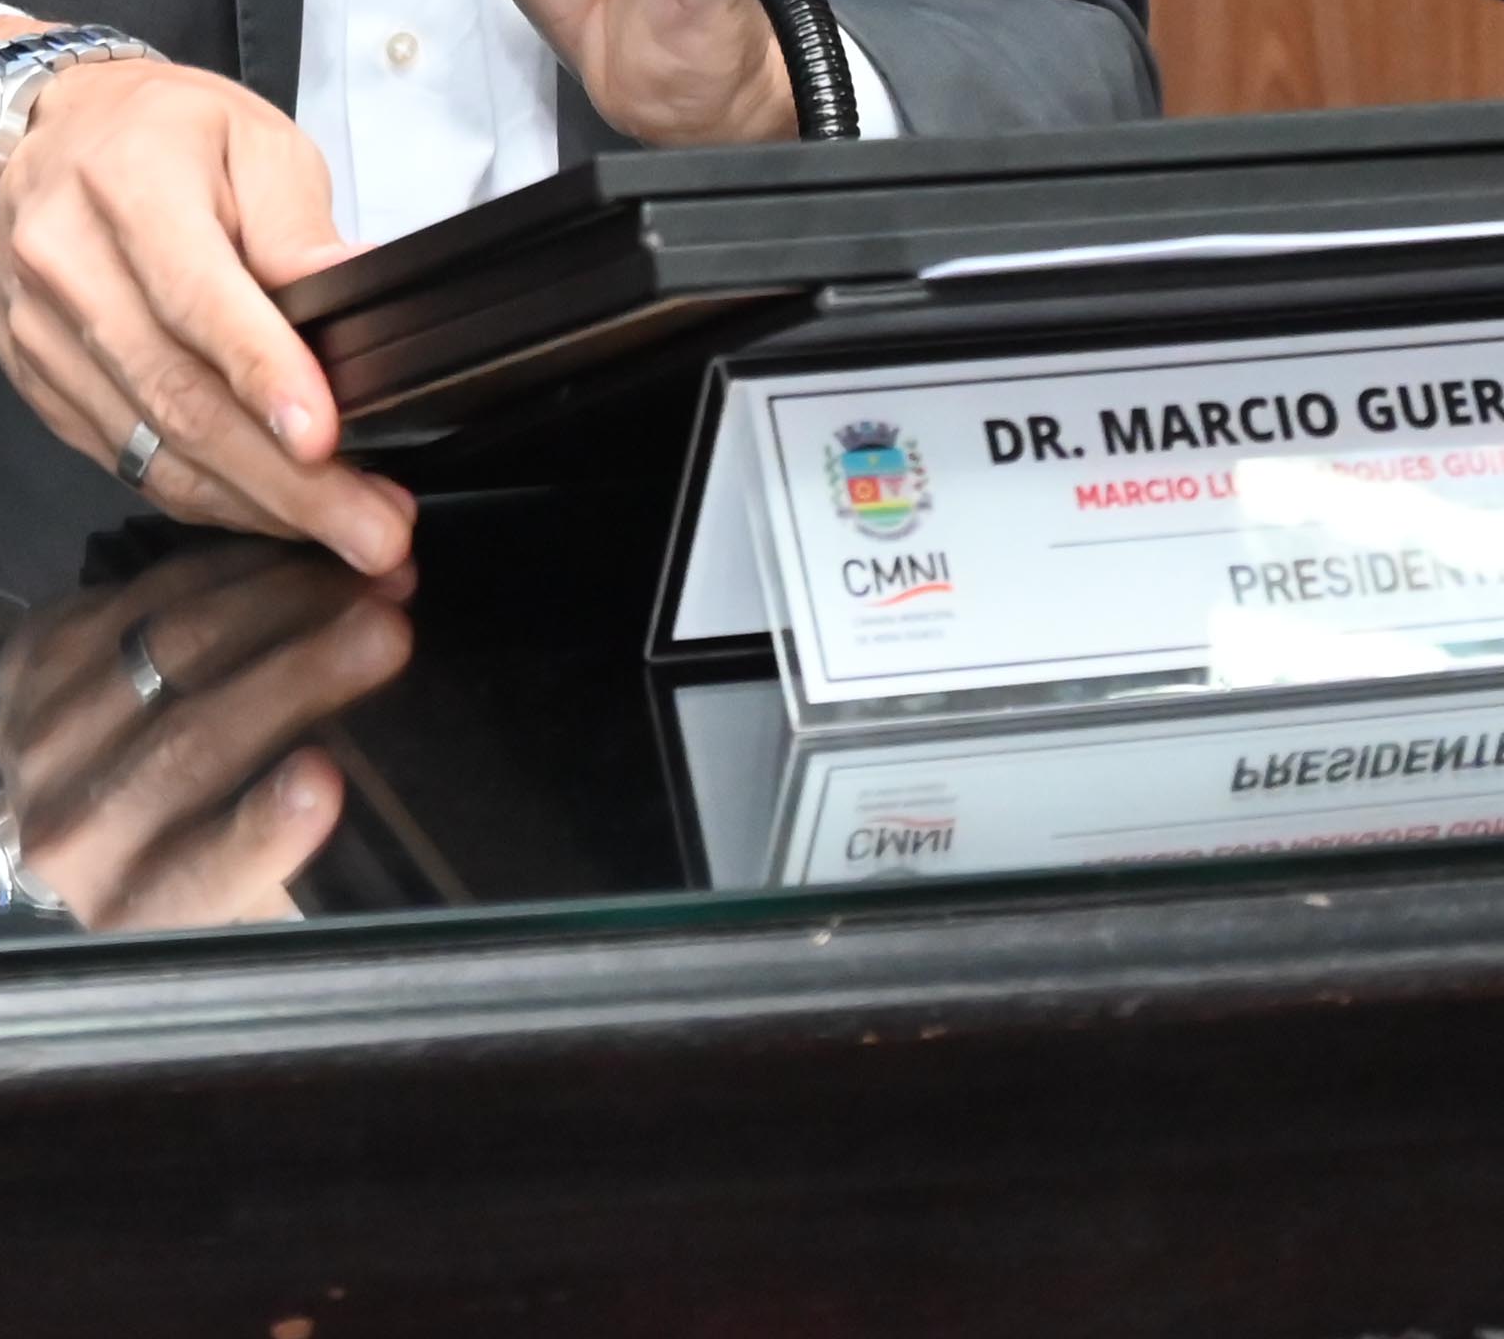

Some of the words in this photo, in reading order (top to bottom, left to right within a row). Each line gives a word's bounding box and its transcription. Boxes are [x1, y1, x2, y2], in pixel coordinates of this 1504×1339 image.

[982, 414, 1085, 465] DR.
[1099, 392, 1338, 455] MARCIO
[1075, 476, 1200, 509] MARCIO
[841, 551, 951, 599] CMNI
